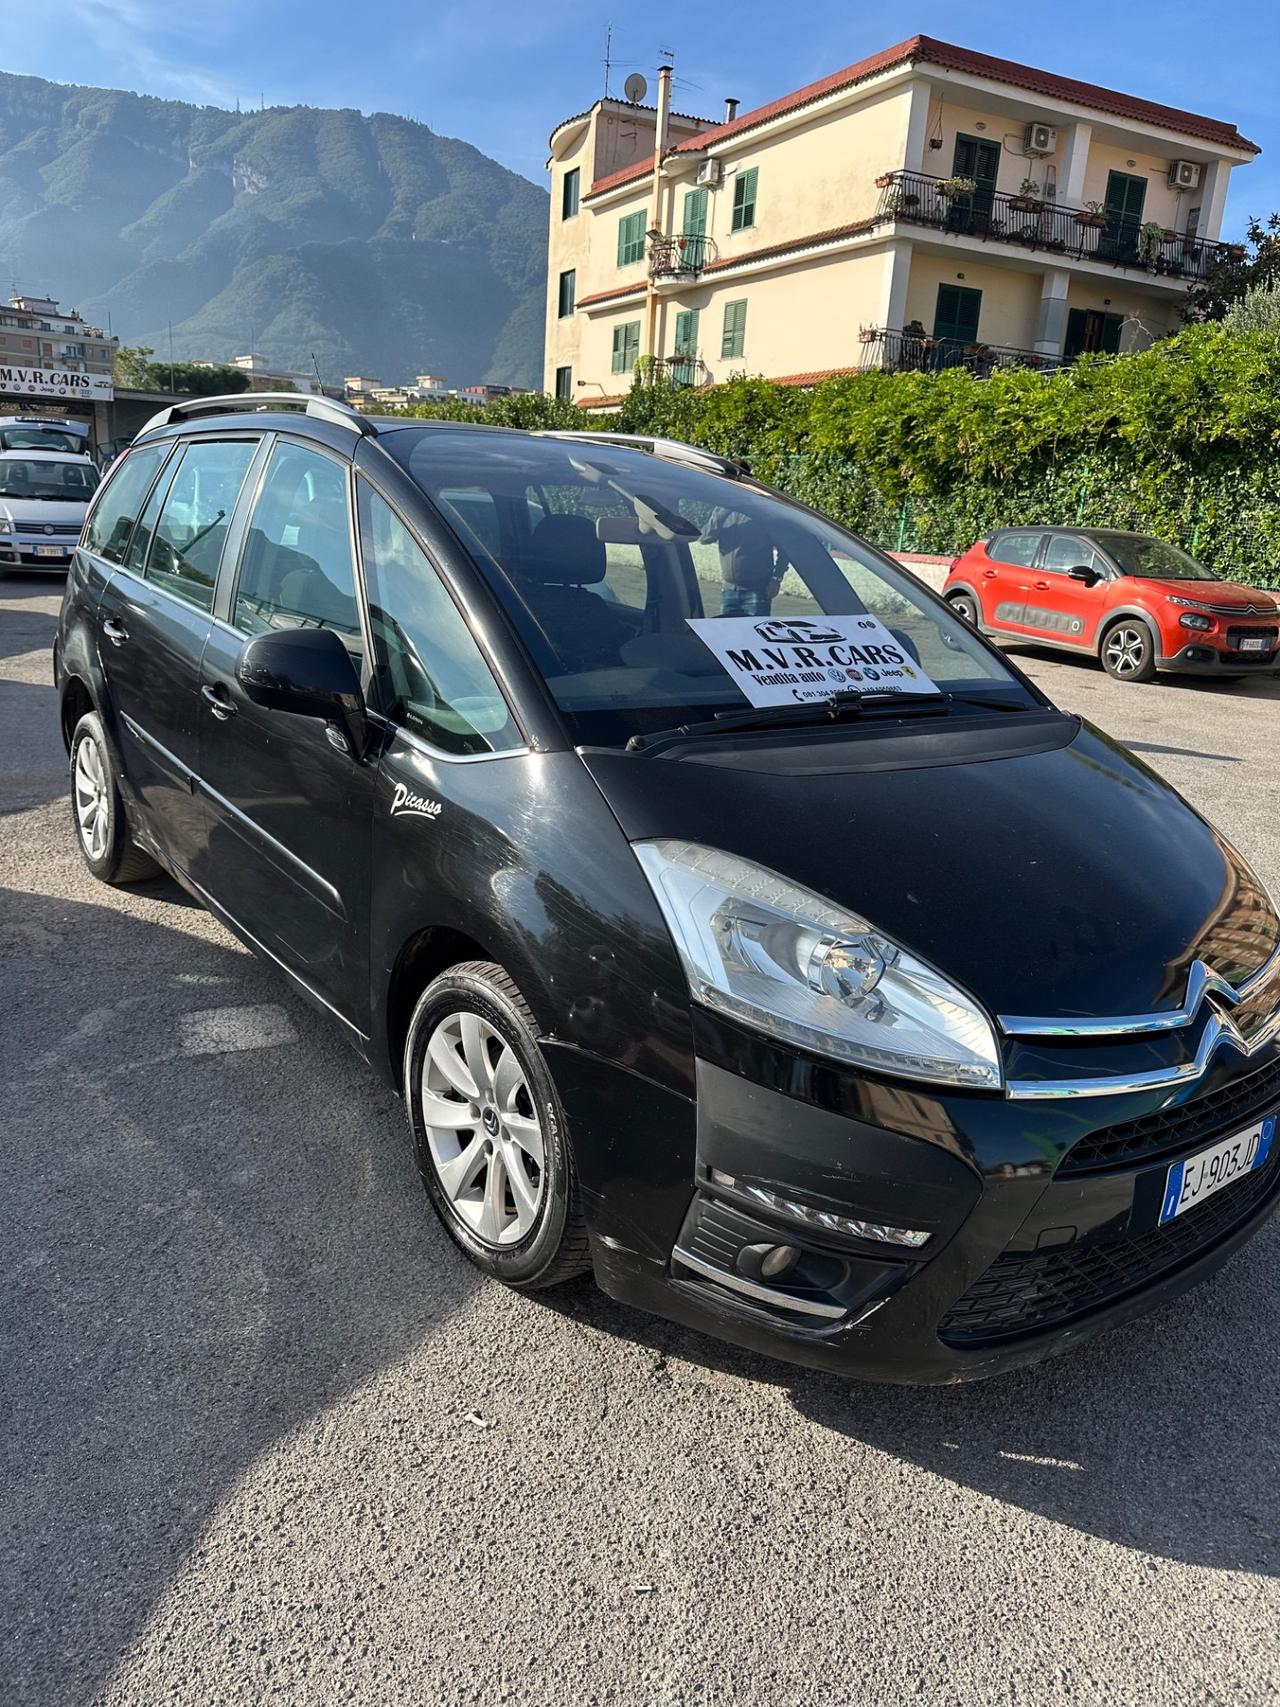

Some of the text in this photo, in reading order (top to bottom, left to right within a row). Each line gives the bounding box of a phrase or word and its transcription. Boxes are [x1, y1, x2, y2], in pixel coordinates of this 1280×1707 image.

[725, 644, 905, 672] M.V.R.CARS
[751, 670, 826, 686] Vendita auto
[880, 668, 904, 678] Jeep
[390, 782, 442, 815] Picasso
